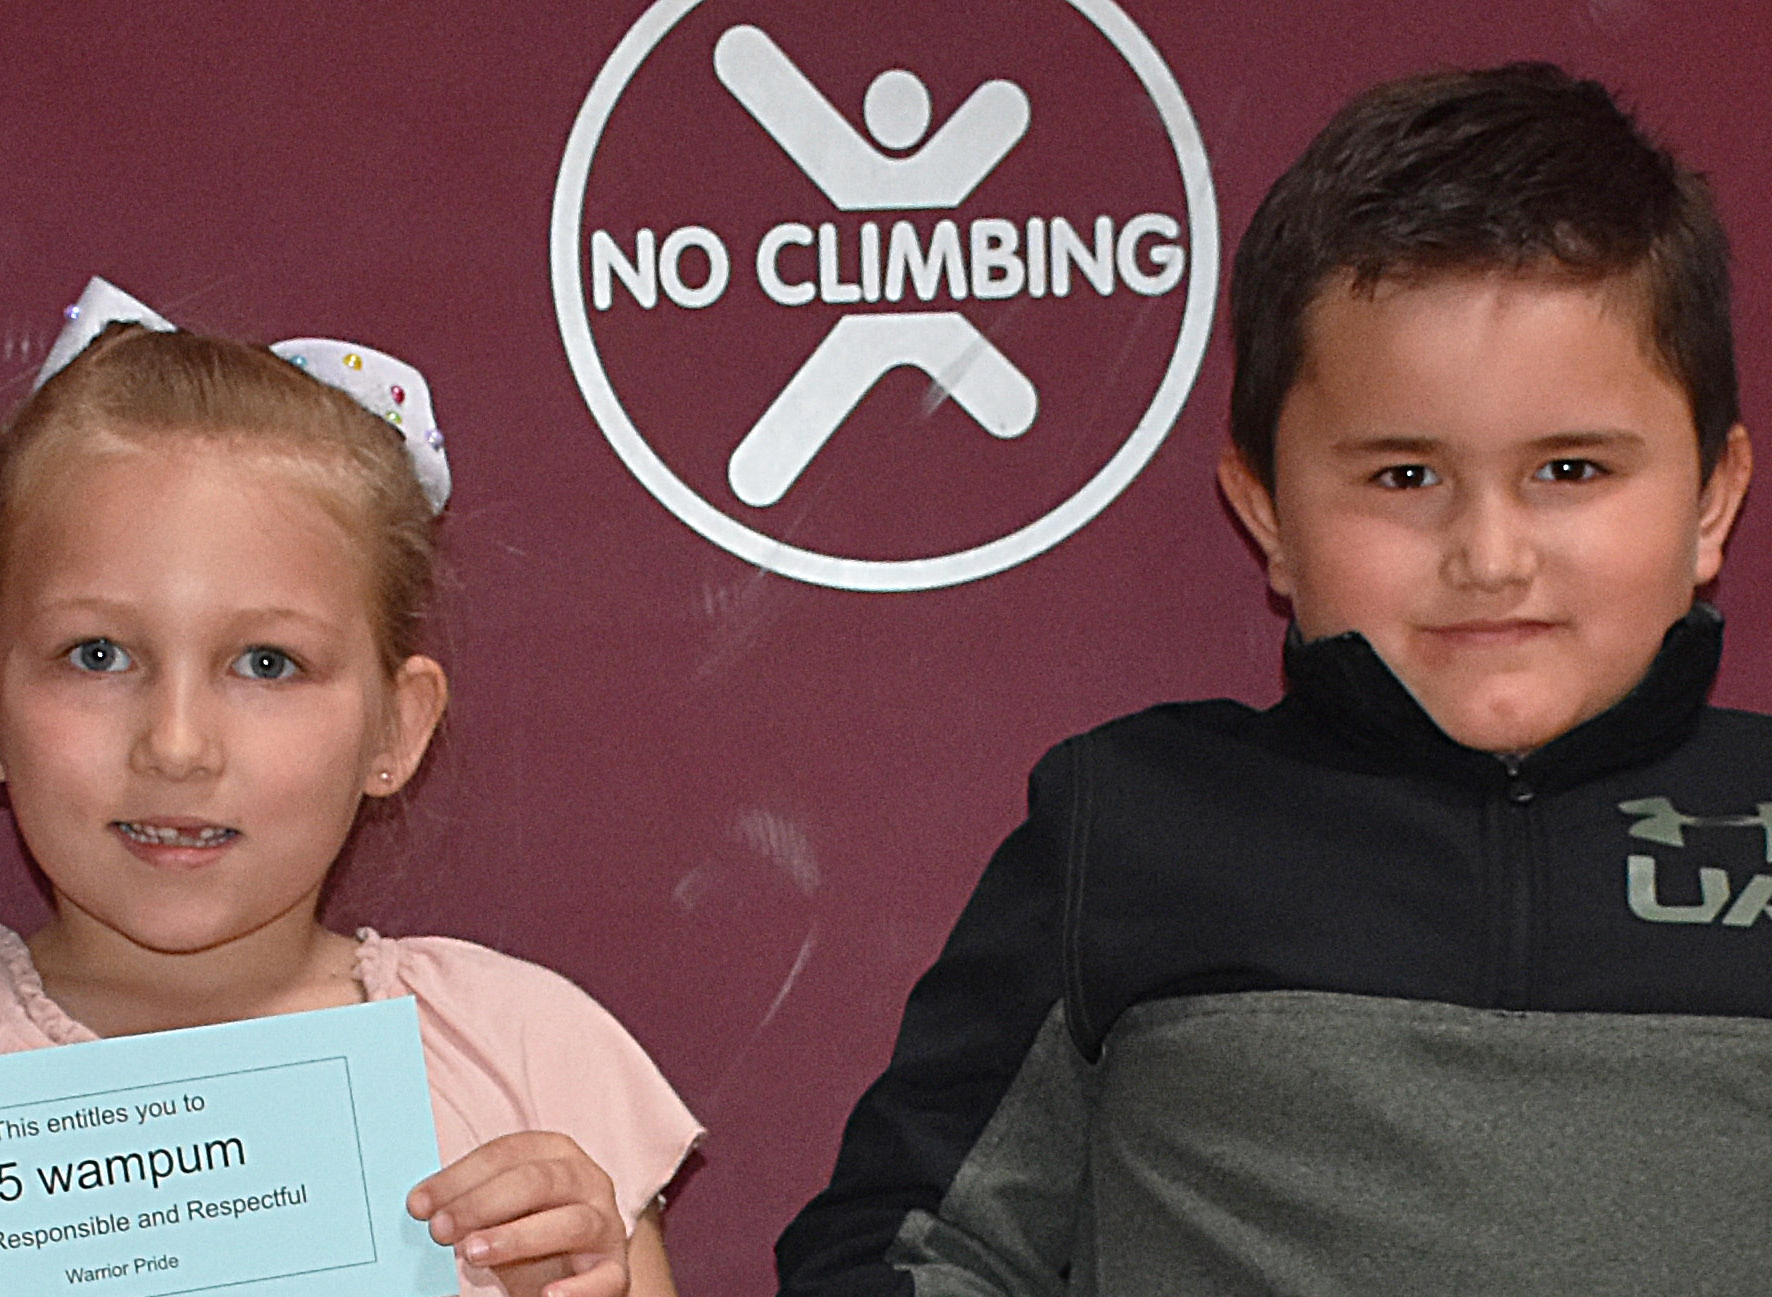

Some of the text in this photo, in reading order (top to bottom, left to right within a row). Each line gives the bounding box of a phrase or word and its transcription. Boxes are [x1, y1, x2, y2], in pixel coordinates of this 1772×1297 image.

[590, 212, 1185, 311] NO CLIMBING
[46, 1105, 129, 1134] entitles
[134, 1099, 177, 1125] you
[183, 1094, 206, 1113] to
[36, 1134, 247, 1195] wampum
[137, 1205, 181, 1229] and
[186, 1184, 308, 1220] Respectful
[65, 1254, 180, 1285] Warrior Pride
